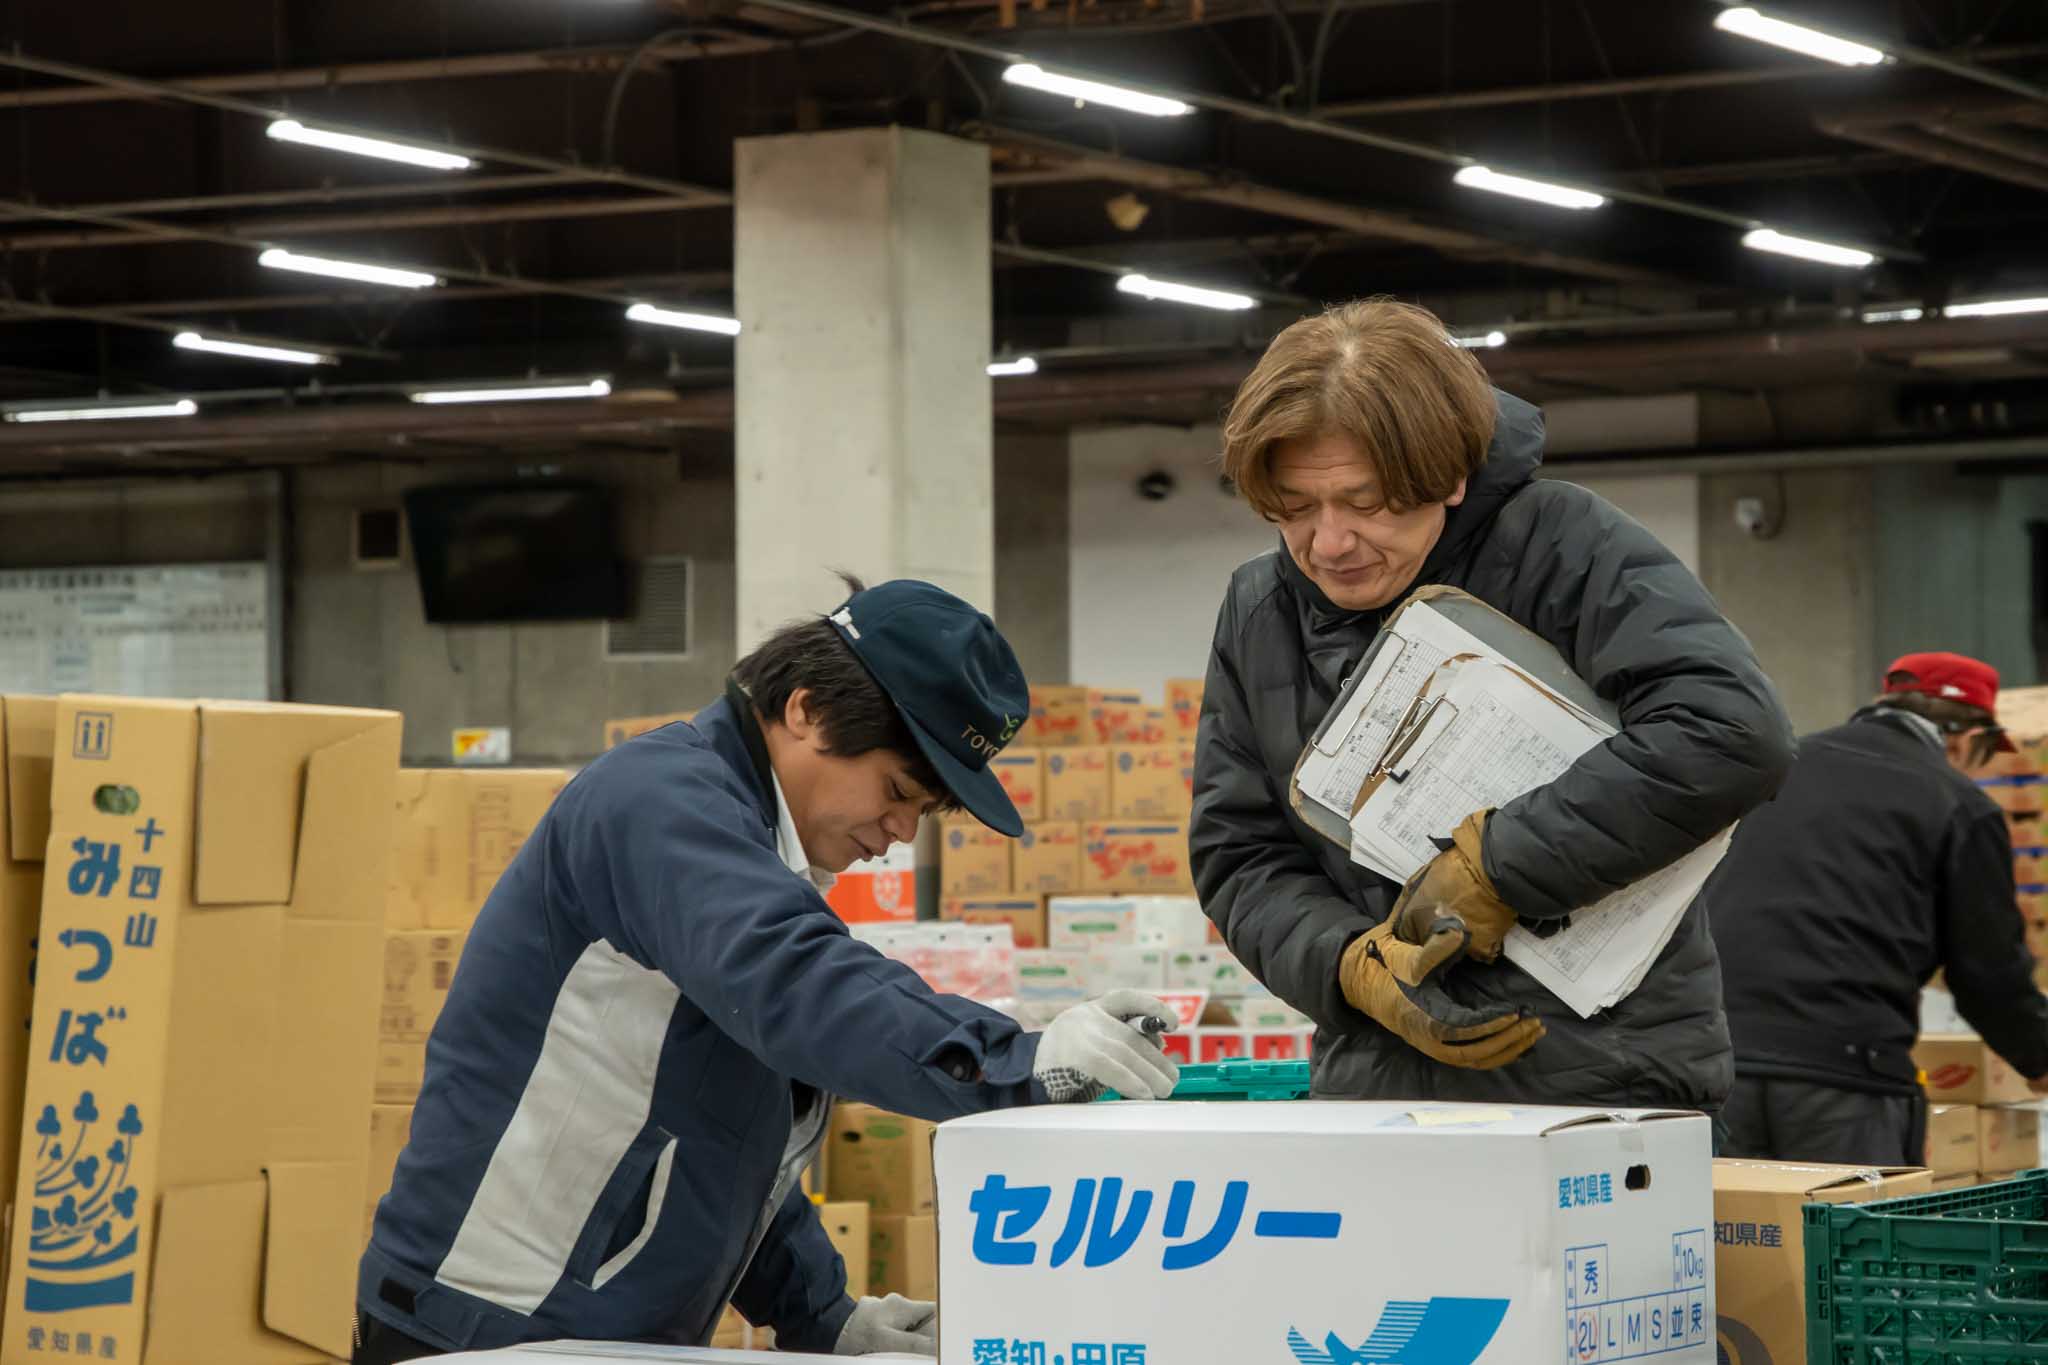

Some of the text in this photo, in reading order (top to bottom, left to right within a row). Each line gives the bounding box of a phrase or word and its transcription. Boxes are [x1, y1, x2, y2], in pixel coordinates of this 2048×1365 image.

[123, 818, 164, 948] 十四山
[49, 836, 127, 1067] みつば
[1558, 1173, 1613, 1209] 愛知県産
[969, 1174, 1342, 1271] セルリー
[1584, 1260, 1599, 1295] 秀
[1683, 1247, 1704, 1279] 10kg
[1578, 1321, 1598, 1353] 2L
[1607, 1317, 1617, 1347] L
[1627, 1311, 1641, 1345] M
[1651, 1308, 1662, 1340] S
